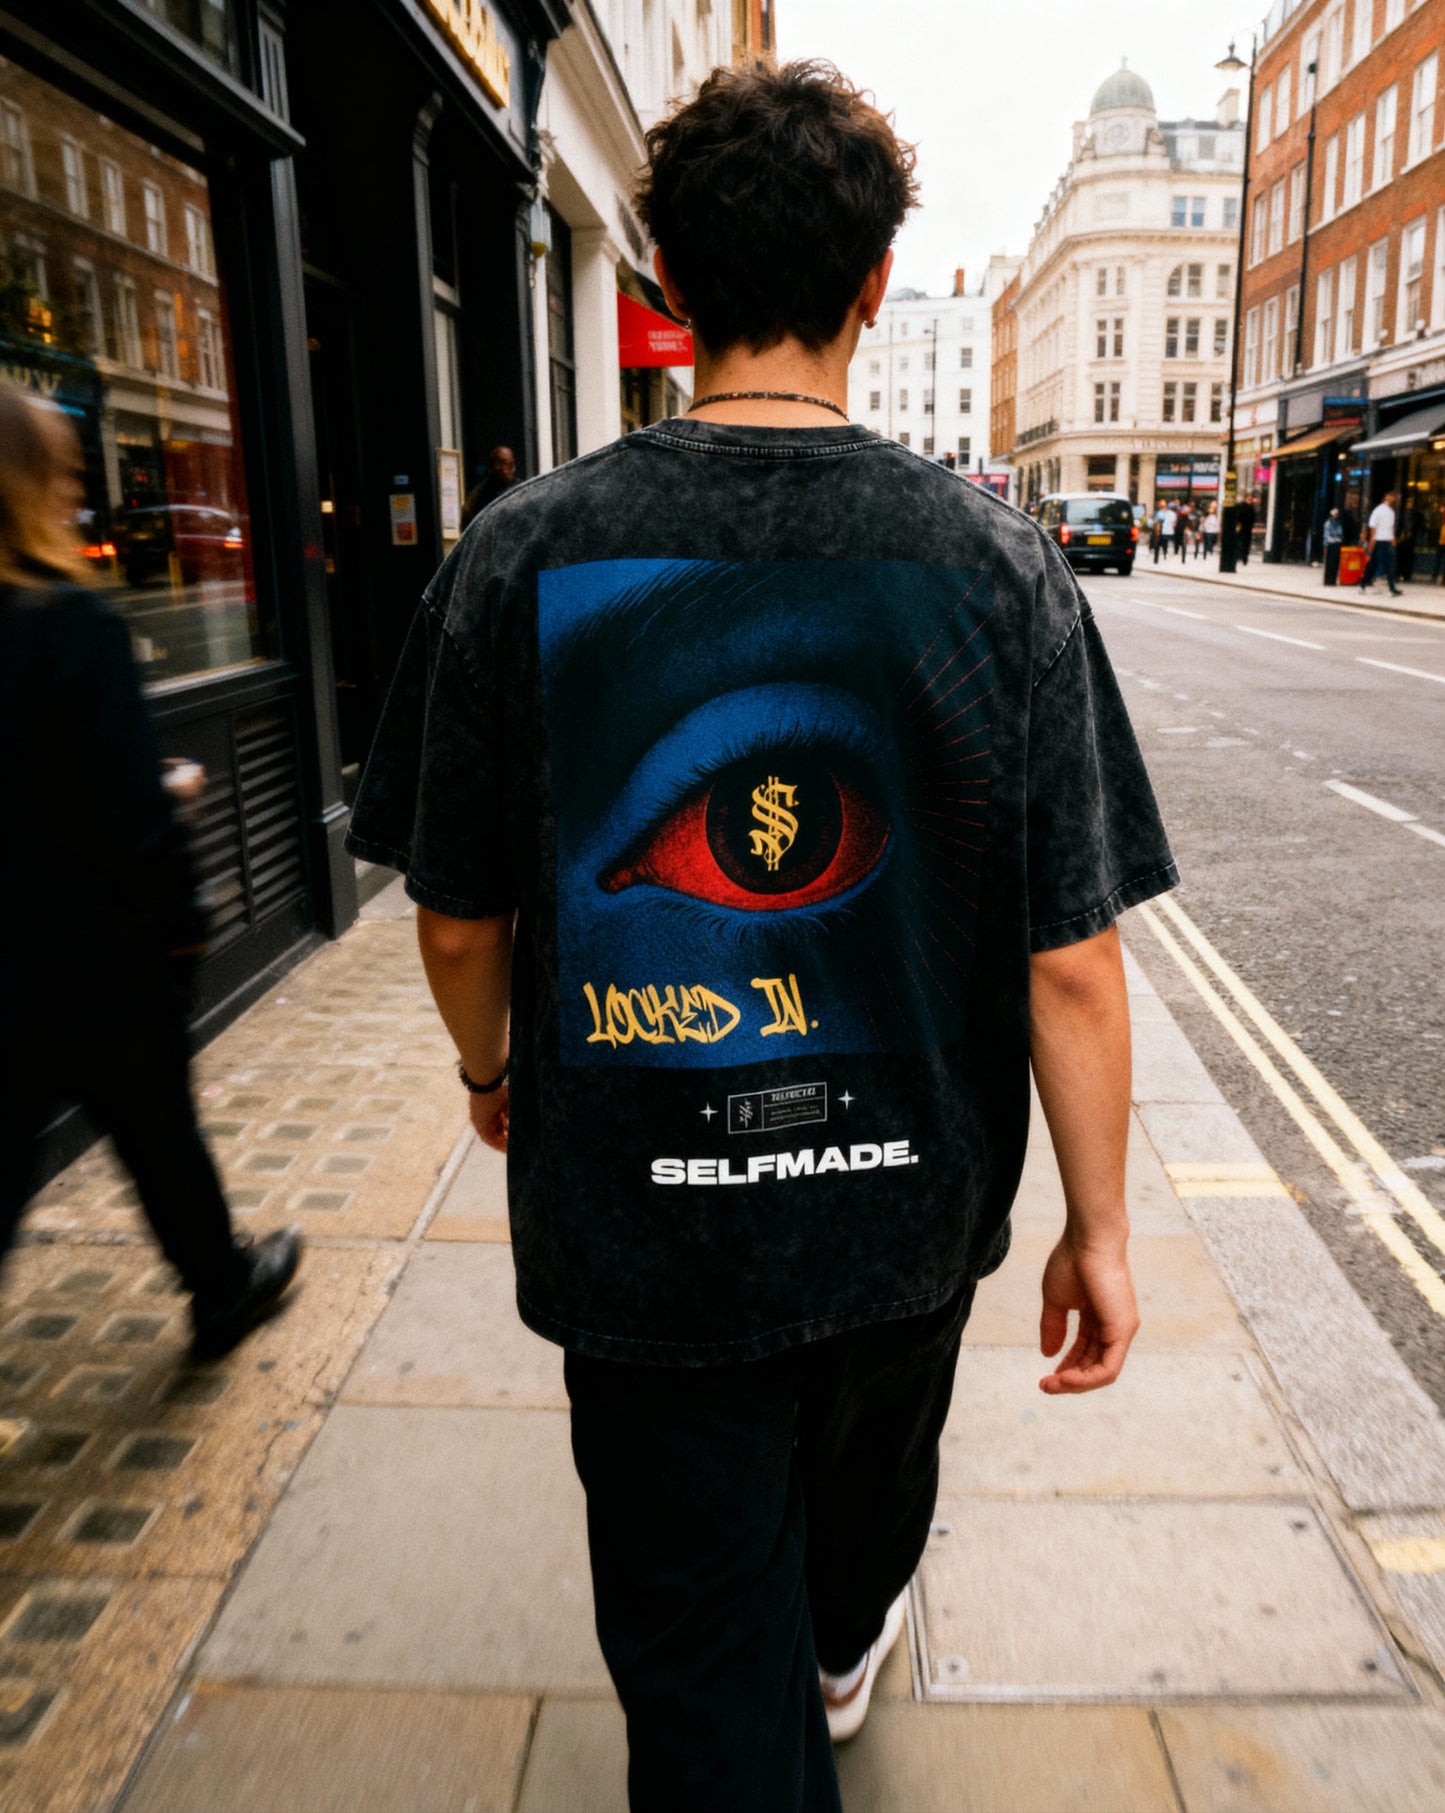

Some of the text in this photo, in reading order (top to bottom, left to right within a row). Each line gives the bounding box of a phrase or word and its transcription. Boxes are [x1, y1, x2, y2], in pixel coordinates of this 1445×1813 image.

[584, 974, 818, 1048] LOCKED IN.
[651, 1140, 918, 1185] SELFMADE.
